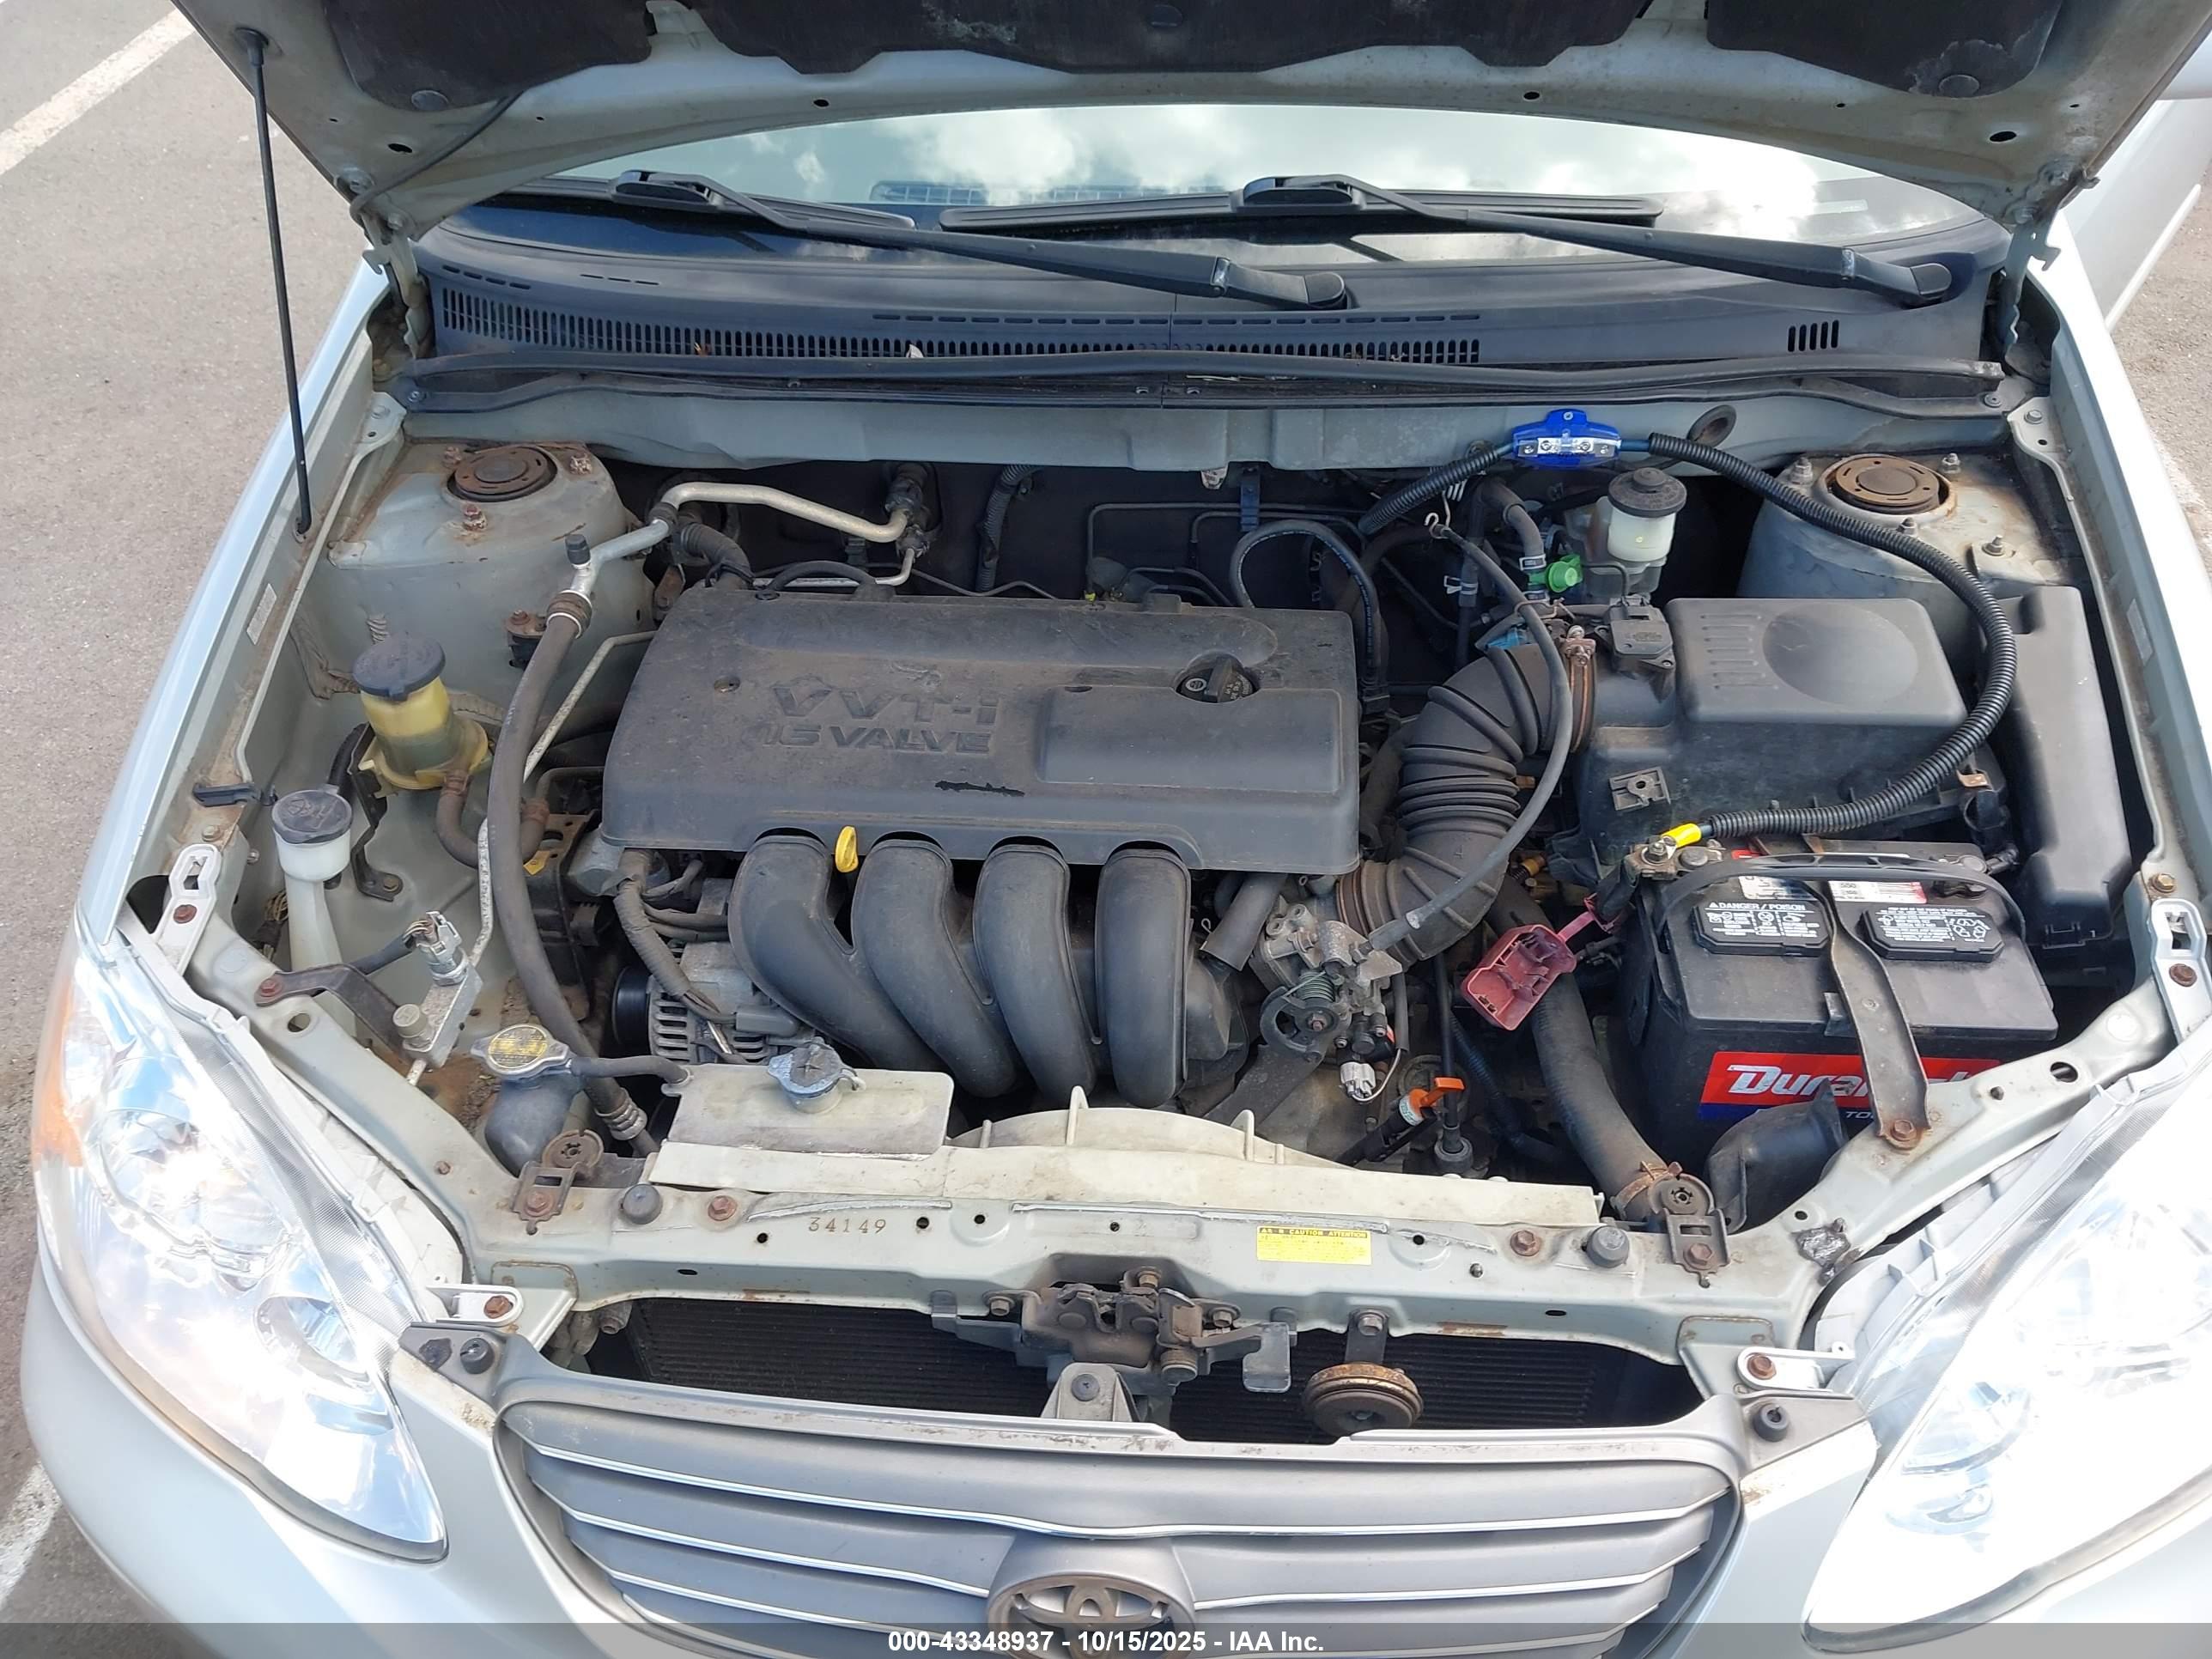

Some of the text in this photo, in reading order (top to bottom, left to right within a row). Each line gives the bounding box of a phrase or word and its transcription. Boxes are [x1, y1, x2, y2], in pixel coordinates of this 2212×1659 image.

[772, 687, 999, 726] VVT-i
[830, 726, 993, 754] VALVE
[808, 1217, 887, 1234] 34149
